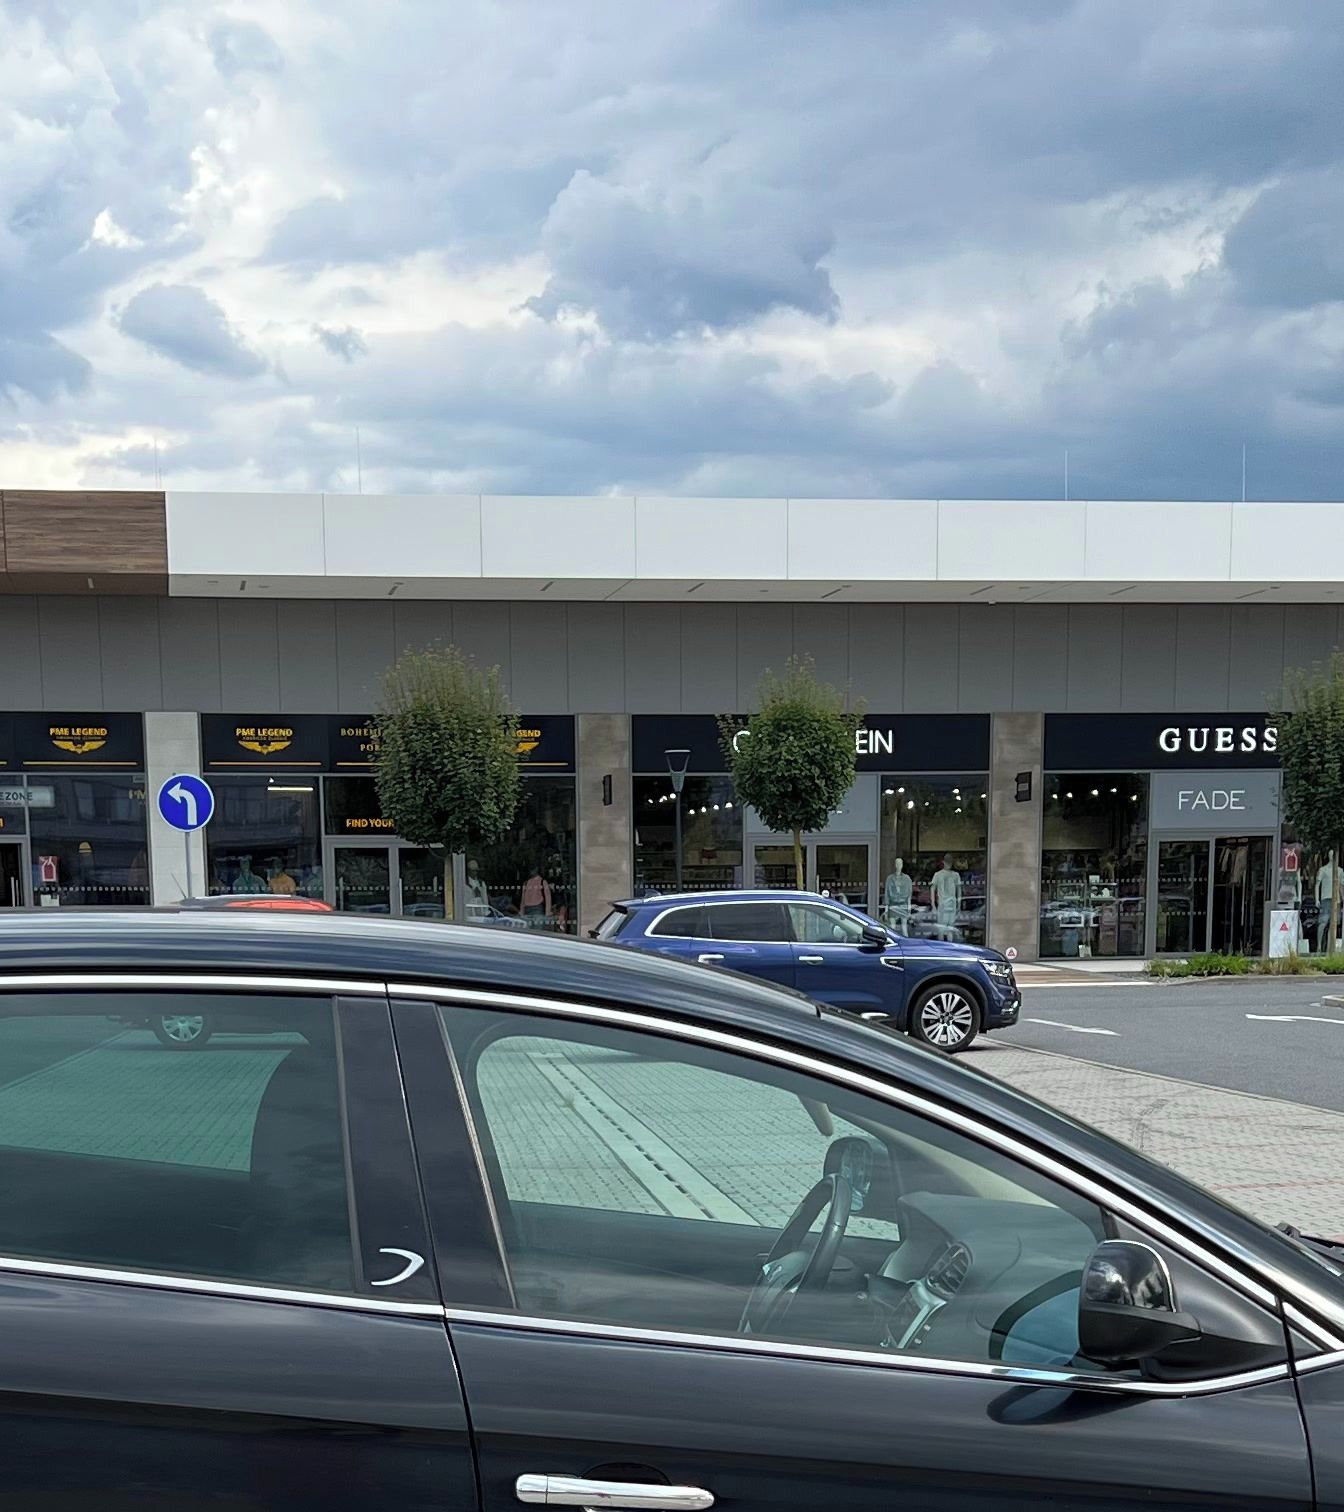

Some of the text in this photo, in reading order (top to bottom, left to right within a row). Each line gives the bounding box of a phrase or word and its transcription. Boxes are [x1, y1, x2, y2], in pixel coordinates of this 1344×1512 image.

[49, 727, 108, 736] PME LEGEND
[236, 727, 293, 736] PME LEGEND
[340, 728, 384, 736] BOHEMI
[856, 729, 893, 754] EIN
[1159, 727, 1278, 752] GUESS
[1178, 790, 1246, 810] FADE
[346, 818, 368, 828] FIND
